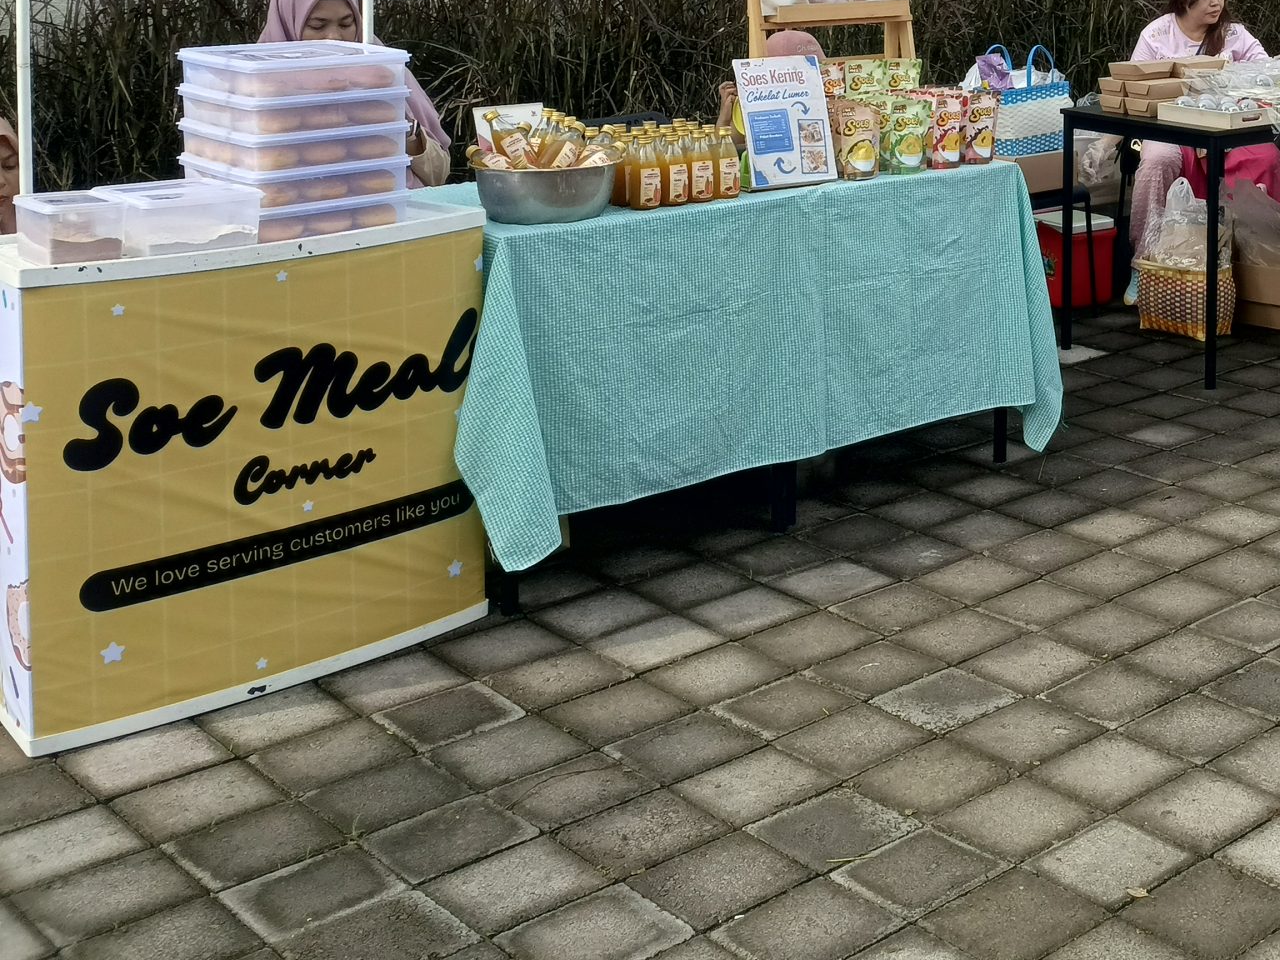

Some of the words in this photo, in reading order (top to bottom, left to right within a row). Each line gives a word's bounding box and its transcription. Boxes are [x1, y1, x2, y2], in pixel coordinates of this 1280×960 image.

[741, 71, 769, 87] Soes
[769, 69, 805, 85] Kering
[746, 89, 781, 103] Cokelat
[781, 89, 810, 100] Lumer
[63, 378, 238, 471] Soe
[254, 307, 478, 430] Meal
[233, 447, 376, 505] Corner
[111, 578, 148, 596] We
[155, 564, 200, 587] love
[206, 543, 285, 573] serving
[289, 514, 391, 553] customers
[396, 500, 425, 523] like
[429, 491, 460, 515] you
